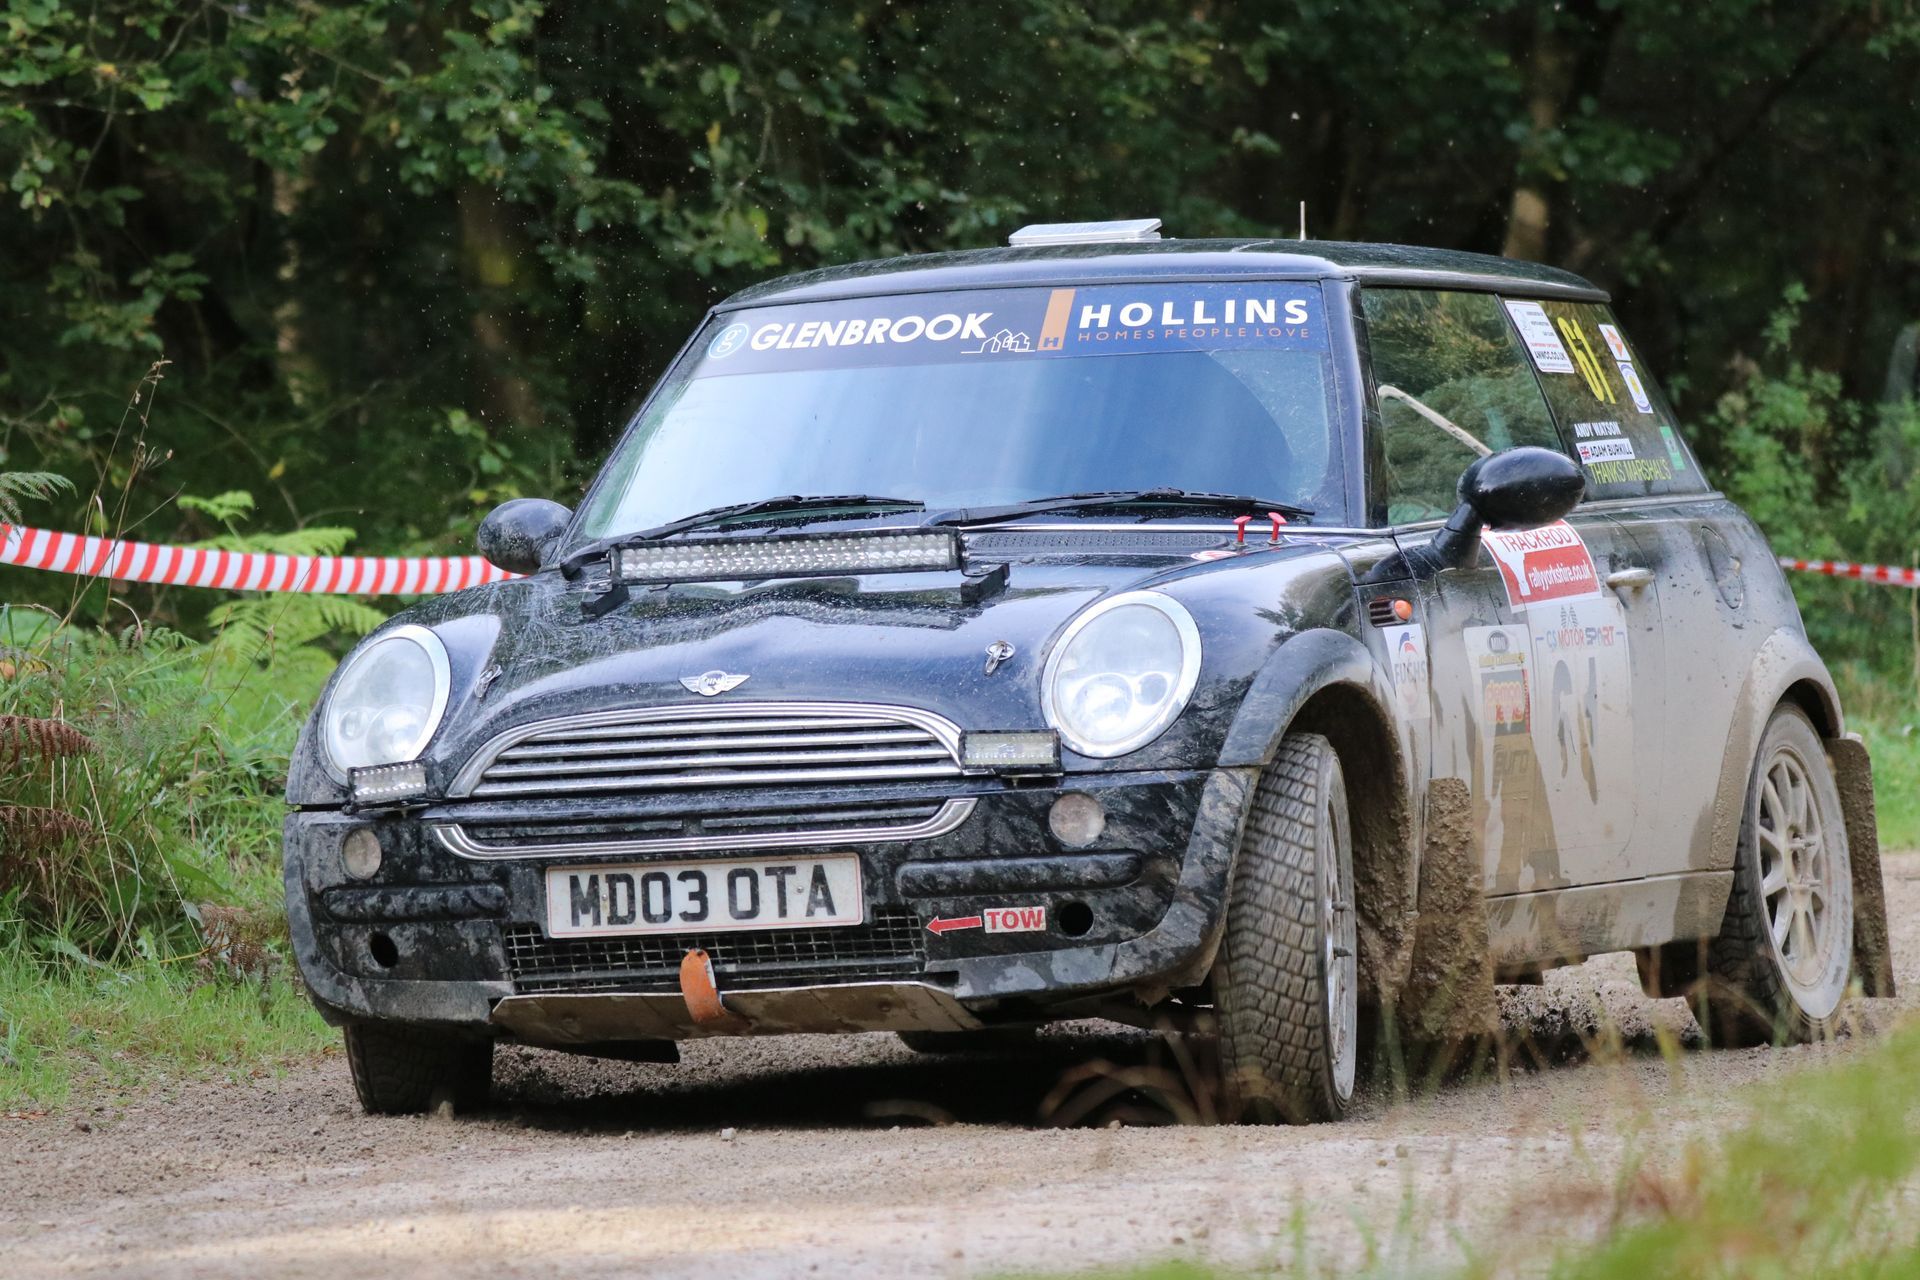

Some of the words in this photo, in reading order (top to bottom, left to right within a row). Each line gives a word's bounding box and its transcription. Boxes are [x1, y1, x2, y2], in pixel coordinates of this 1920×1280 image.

[1078, 299, 1309, 329] HOLLINS
[751, 312, 993, 351] GLENBROOK
[1043, 337, 1058, 348] H
[1078, 329, 1155, 342] HOMES
[1164, 327, 1246, 339] PEOPLE
[1256, 327, 1310, 339] LOVE
[1574, 422, 1594, 438] ANDY
[1591, 421, 1621, 437] WATSON
[1590, 444, 1610, 458] ADAM
[1587, 459, 1626, 485] THANKS
[1495, 527, 1572, 553] TRACKROD
[1528, 559, 1593, 591] rallyyorkshire.co.uk
[1557, 628, 1584, 649] MOTOR
[1394, 659, 1426, 684] FUCHS
[569, 870, 708, 929] MD03
[727, 864, 836, 921] OTA
[987, 908, 1044, 931] TOW
